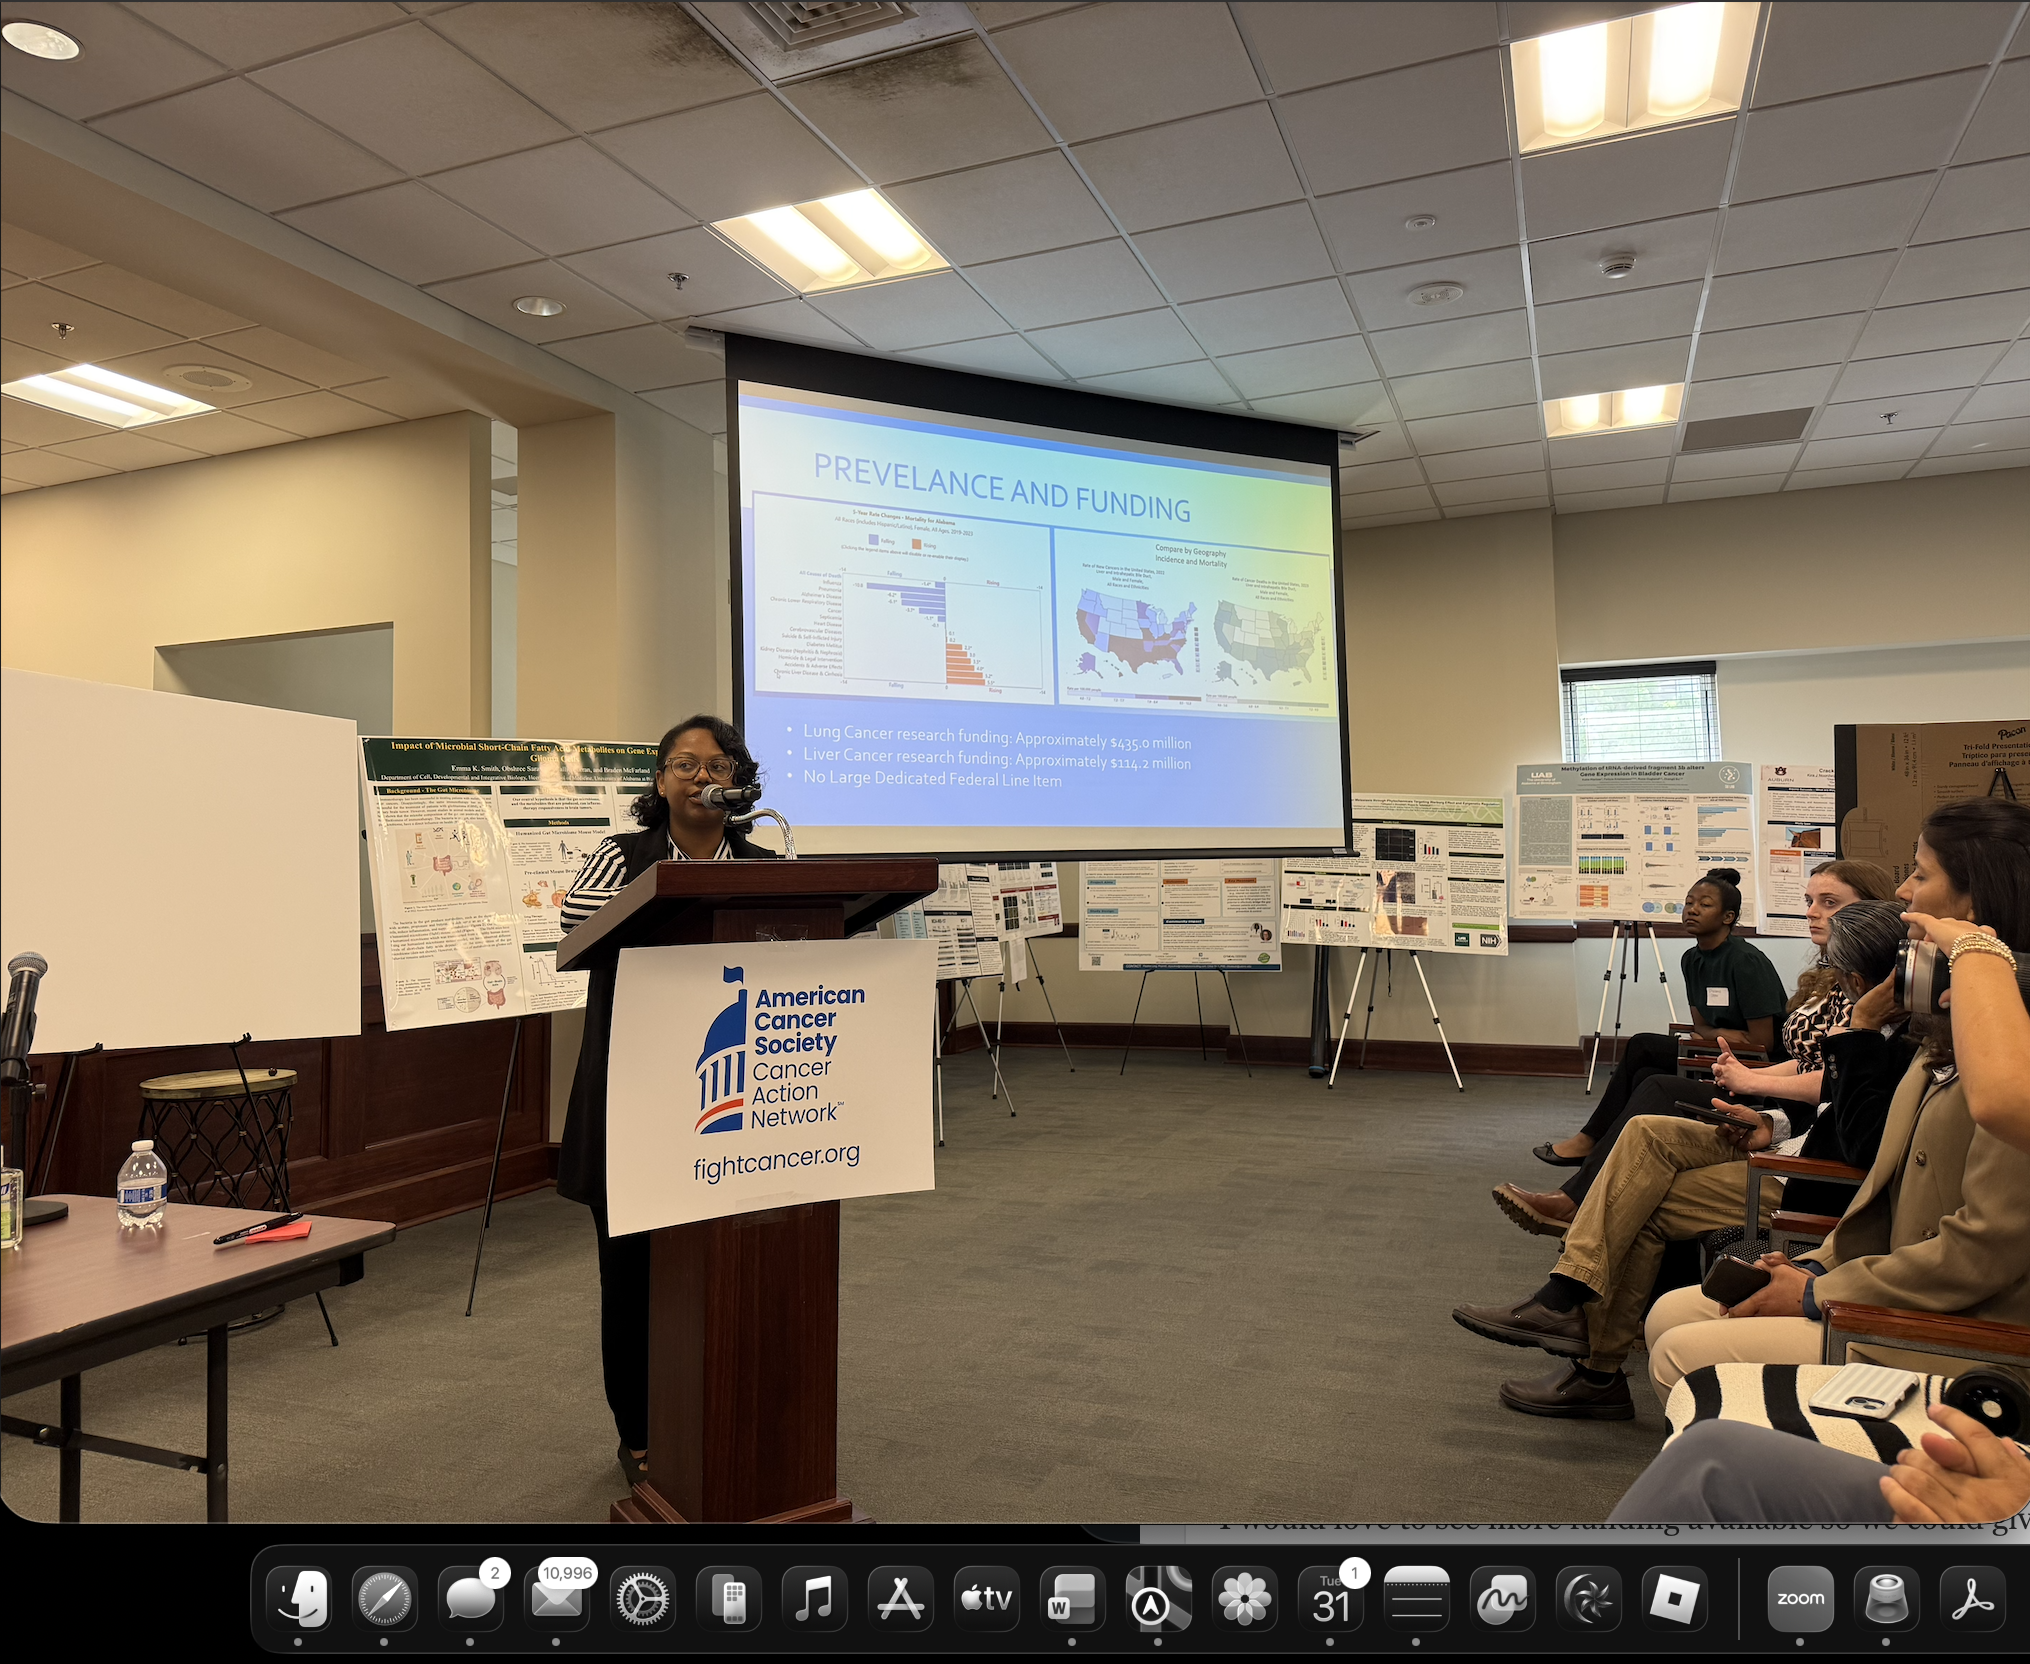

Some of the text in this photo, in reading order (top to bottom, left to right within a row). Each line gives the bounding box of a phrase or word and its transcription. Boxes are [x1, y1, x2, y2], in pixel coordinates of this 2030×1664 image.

[815, 452, 1190, 522] PREVELANCE AND FUNDING
[905, 515, 926, 523] Mortality
[1156, 544, 1227, 559] Compare by Geography
[1156, 555, 1185, 564] Incidence
[1199, 559, 1228, 569] Mortality
[804, 723, 1192, 752] Lung Cancer research funding: Approximately $435.0 million
[1998, 726, 2026, 740] Pacon
[392, 742, 423, 751] Impact
[425, 742, 433, 750] of
[435, 742, 476, 751] Microbial
[478, 743, 529, 753] Short-Chain
[531, 744, 551, 754] Fatty
[573, 745, 615, 754] Metabolites
[804, 747, 1191, 772] Liver Cancer research funding: Approximately $114.2 million
[1982, 760, 2019, 768] d'affichage
[804, 770, 1062, 788] No Large Dedicated Federal Line Item
[755, 985, 865, 1008] American
[755, 1010, 836, 1031] Cancer
[755, 1032, 837, 1056] Society
[753, 1059, 832, 1081] Cancer
[752, 1083, 818, 1105] Action
[752, 1102, 837, 1129] Network
[694, 1144, 860, 1185] fightcancer.org
